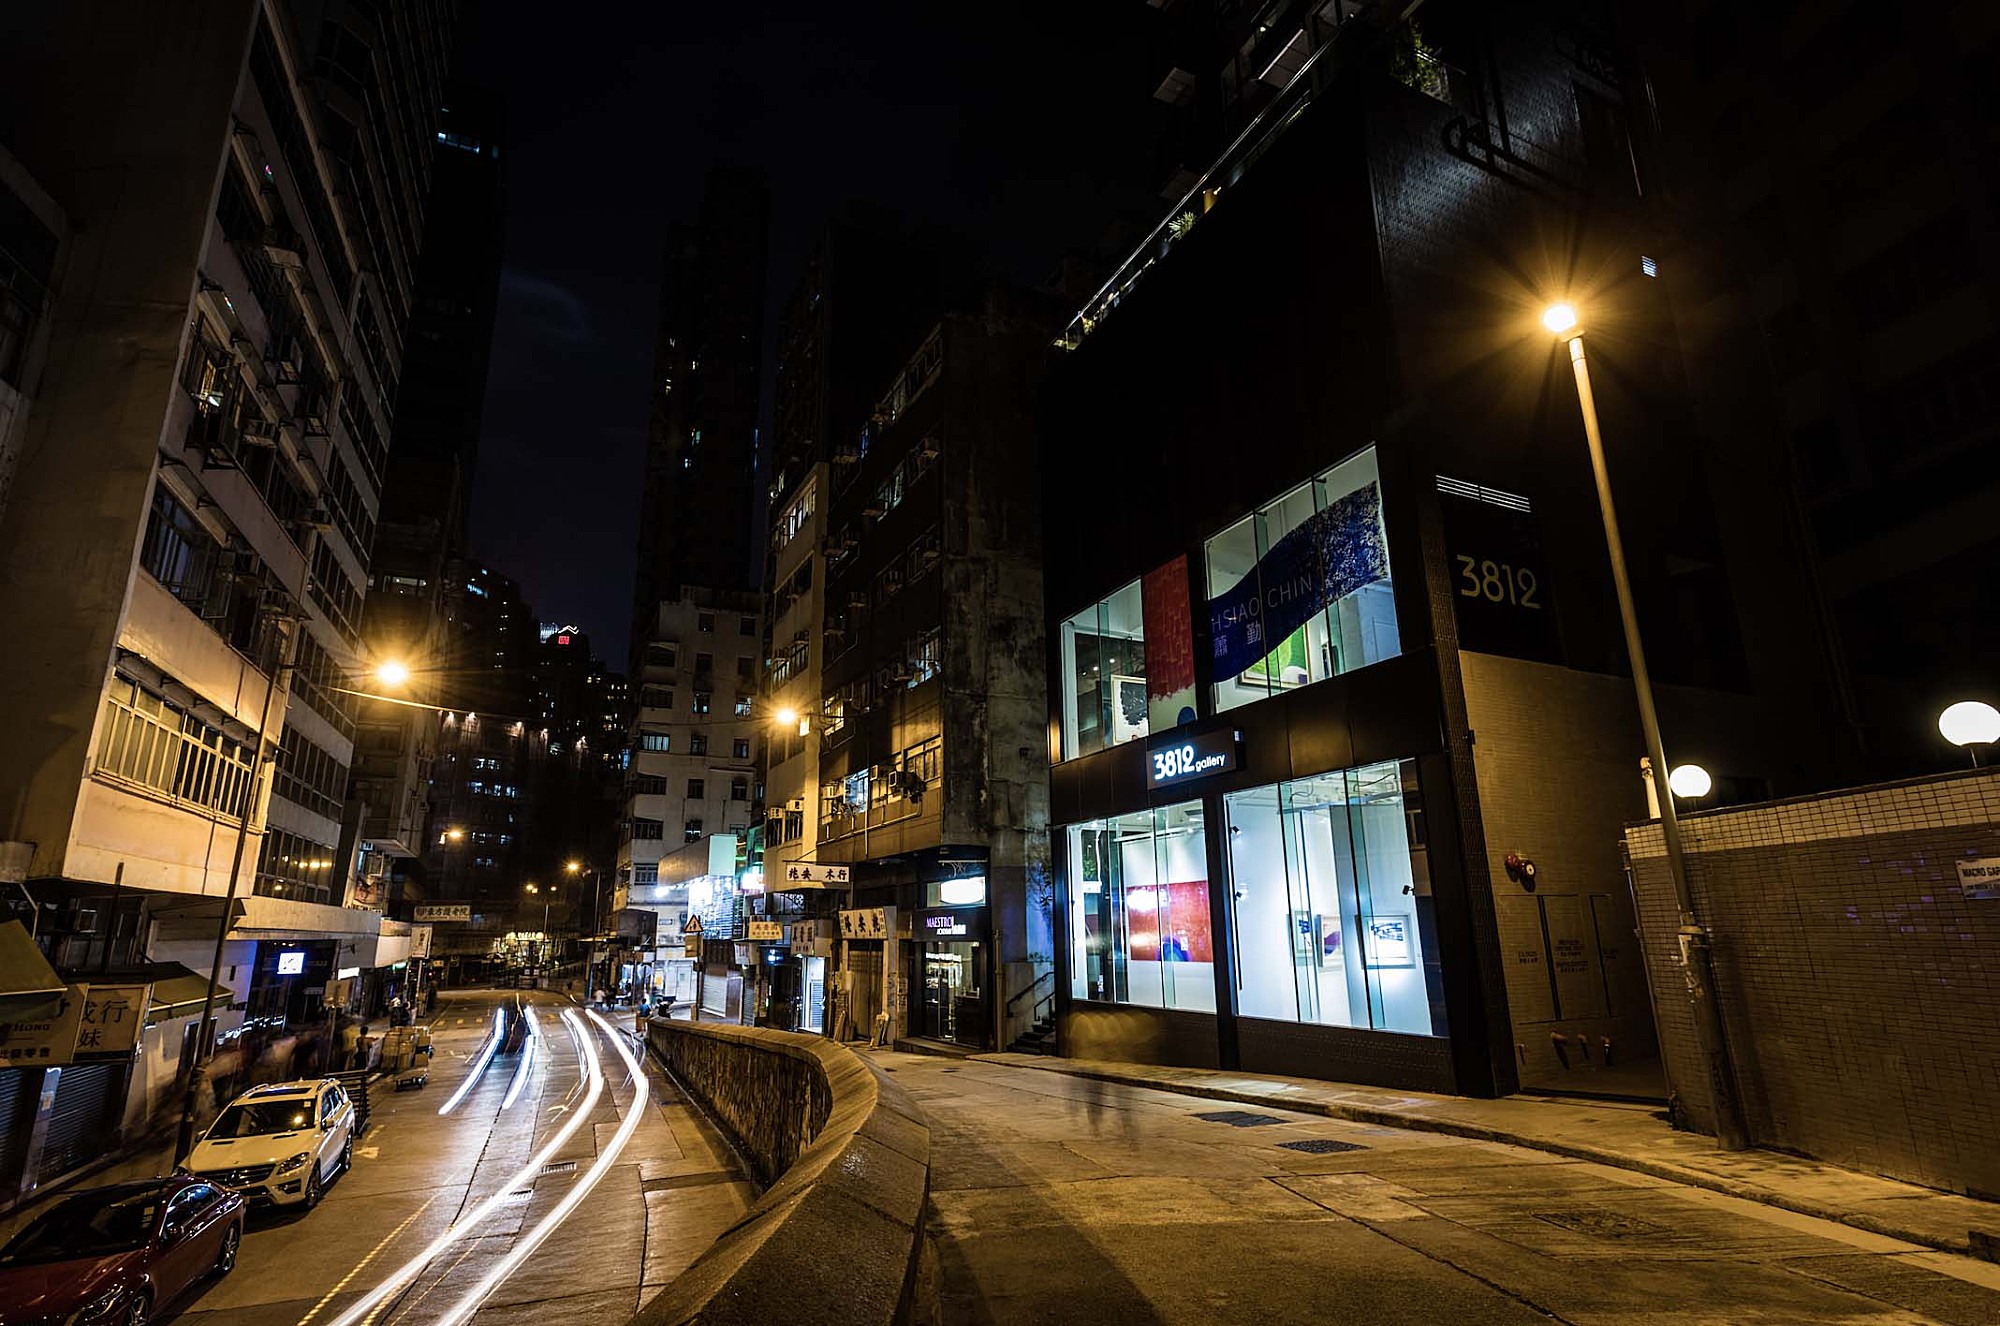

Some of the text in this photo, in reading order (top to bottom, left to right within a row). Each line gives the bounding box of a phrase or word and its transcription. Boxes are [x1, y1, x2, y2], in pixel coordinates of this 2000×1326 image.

[1211, 572, 1312, 632] HSIAO CHIN
[1457, 554, 1542, 609] 3812
[1153, 745, 1226, 780] 3812 gallery
